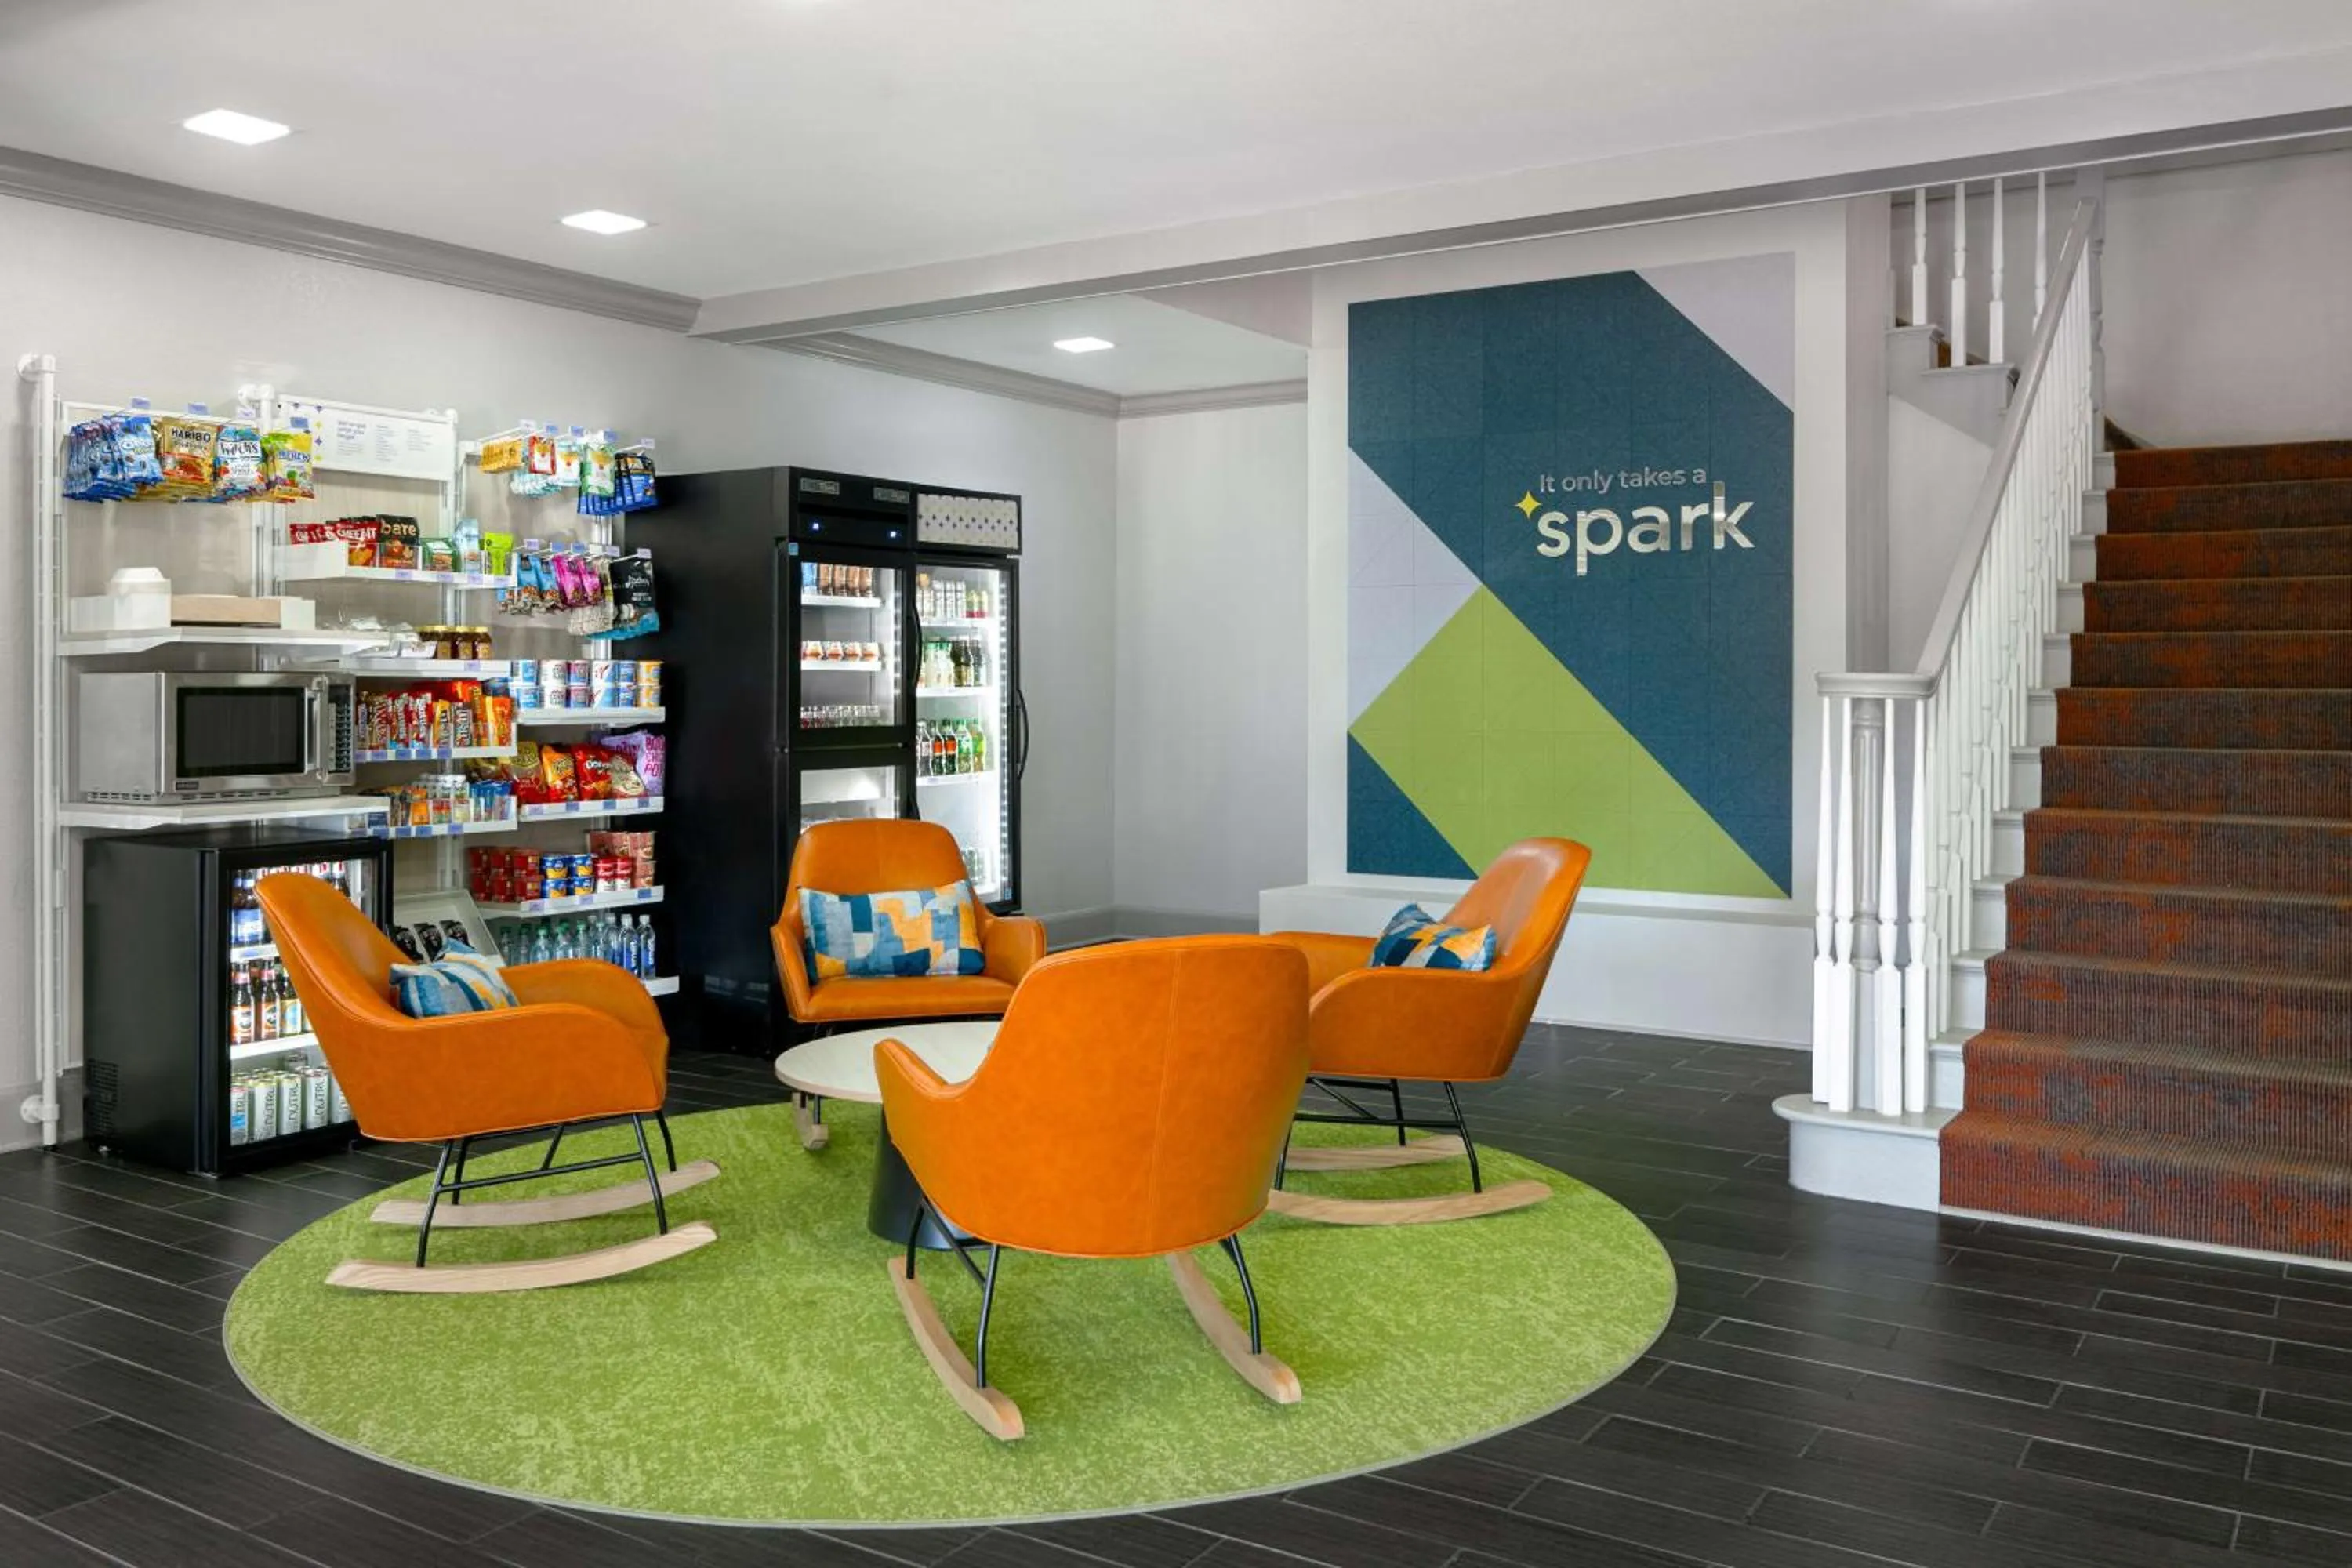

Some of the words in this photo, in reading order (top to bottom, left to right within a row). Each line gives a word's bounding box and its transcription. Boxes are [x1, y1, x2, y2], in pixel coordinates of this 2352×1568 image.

[172, 428, 211, 442] HARIBO
[1540, 474, 1555, 492] It
[1561, 470, 1613, 494] only
[1618, 466, 1686, 488] takes
[1693, 468, 1707, 484] a
[380, 519, 416, 536] bare
[1537, 481, 1755, 576] spark
